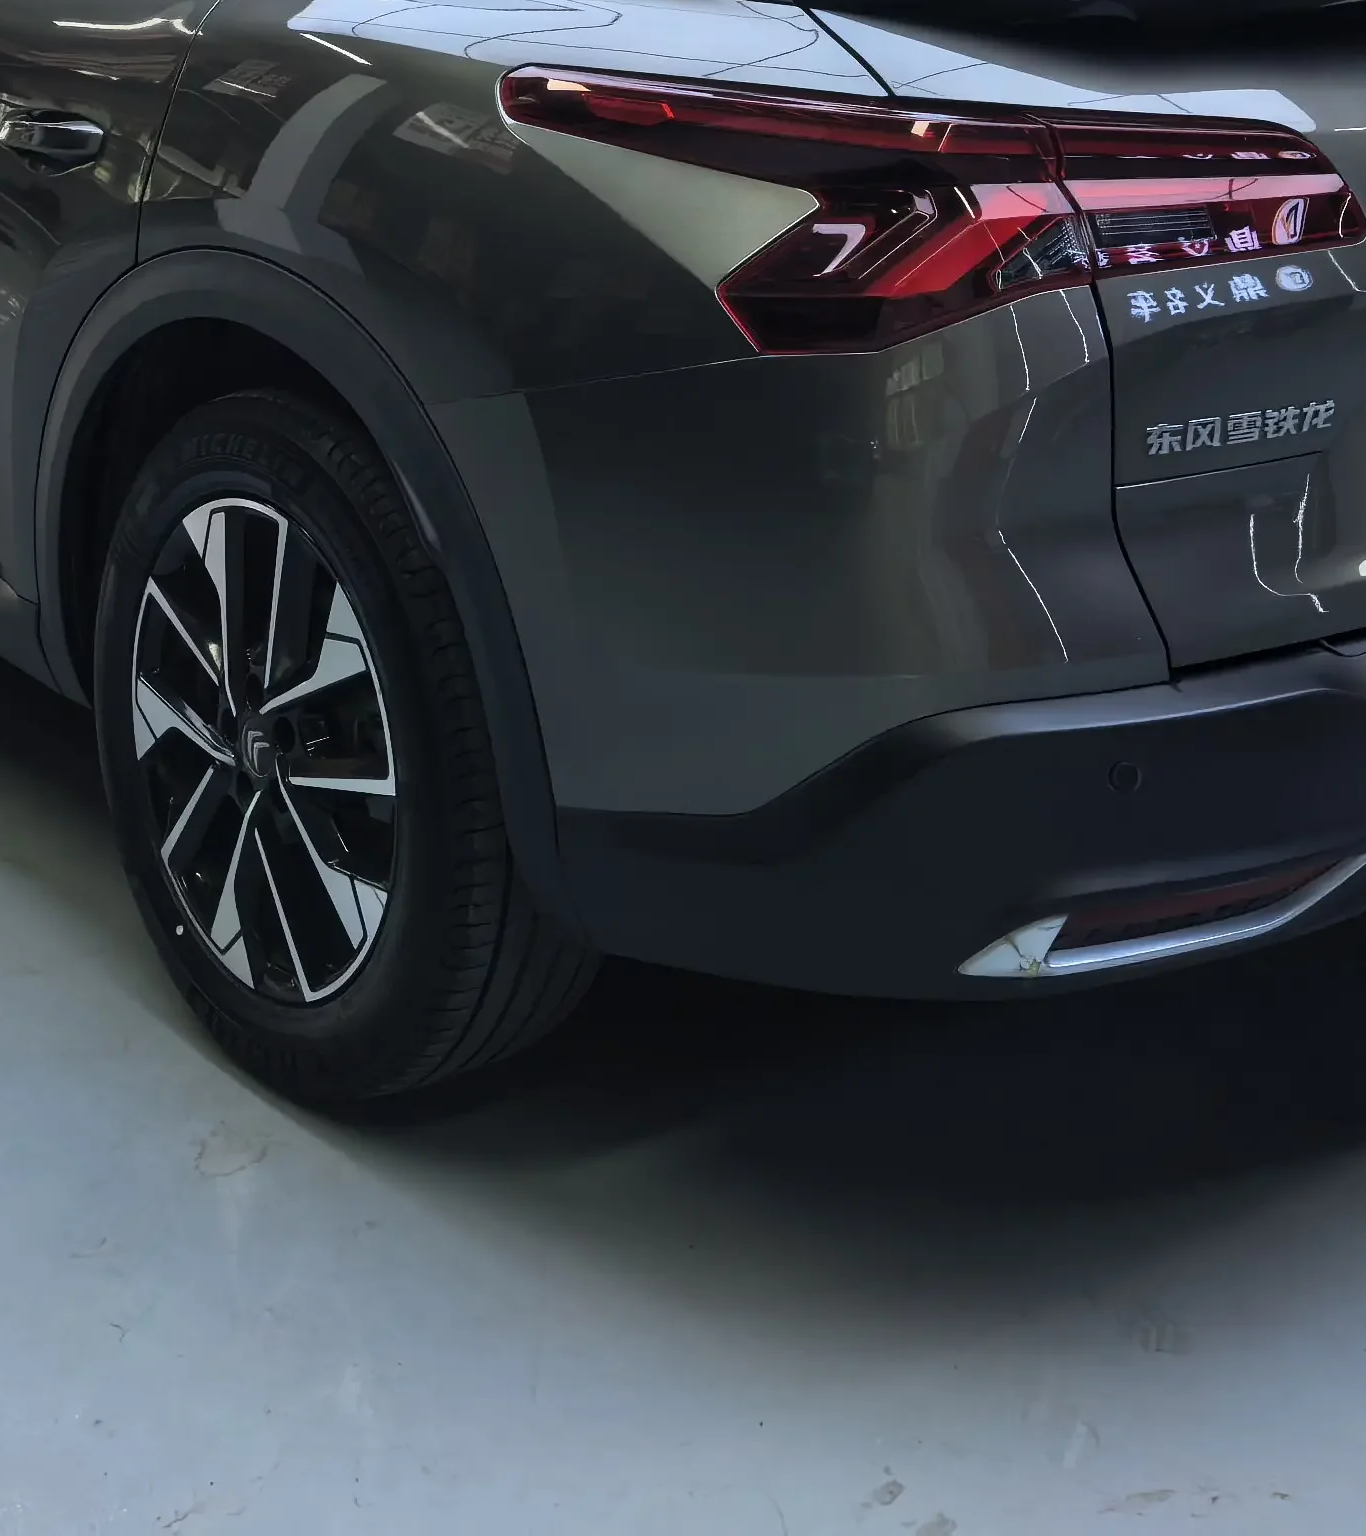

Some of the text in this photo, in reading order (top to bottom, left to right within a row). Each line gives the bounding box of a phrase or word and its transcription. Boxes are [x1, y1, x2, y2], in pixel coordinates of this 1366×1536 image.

[1147, 400, 1335, 455] 东风雪铁龙
